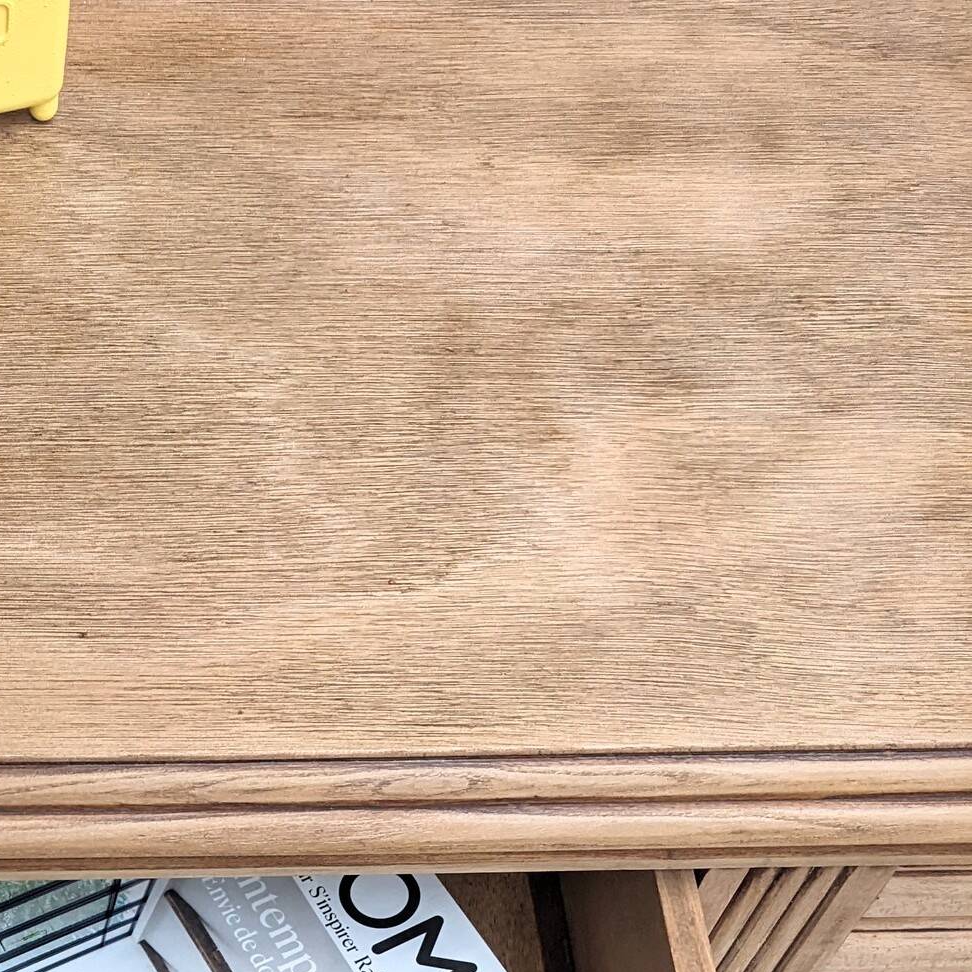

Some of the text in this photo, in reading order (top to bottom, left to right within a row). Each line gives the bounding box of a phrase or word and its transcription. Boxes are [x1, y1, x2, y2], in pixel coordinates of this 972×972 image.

[201, 877, 242, 926] Envie
[234, 927, 258, 952] de
[308, 885, 358, 952] S'inspirer
